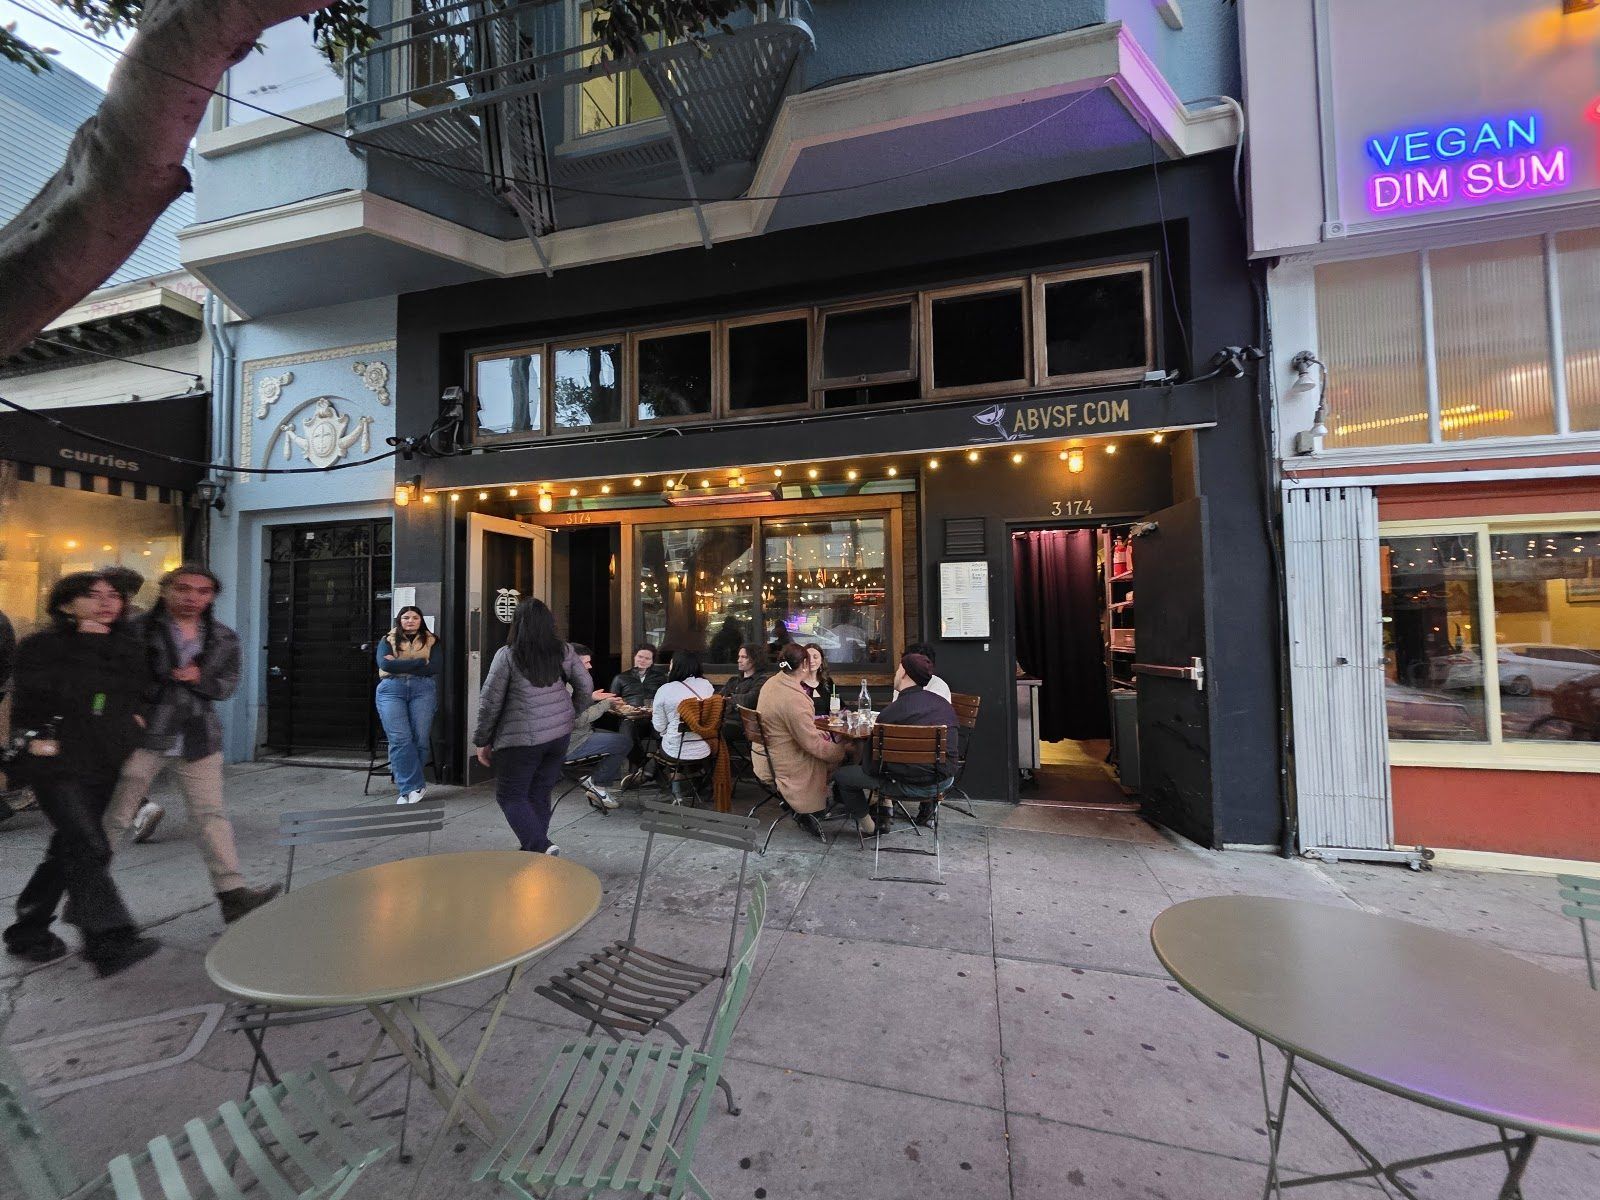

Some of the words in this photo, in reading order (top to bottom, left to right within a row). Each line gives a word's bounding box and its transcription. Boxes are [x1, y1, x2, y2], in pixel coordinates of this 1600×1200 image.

[1371, 115, 1537, 167] VEGAN
[1373, 167, 1449, 209] DIM
[1465, 150, 1566, 195] SUM
[1013, 398, 1130, 433] ABVSF.COM
[59, 447, 140, 472] curries
[566, 511, 592, 525] 3174
[1051, 499, 1094, 516] 3174
